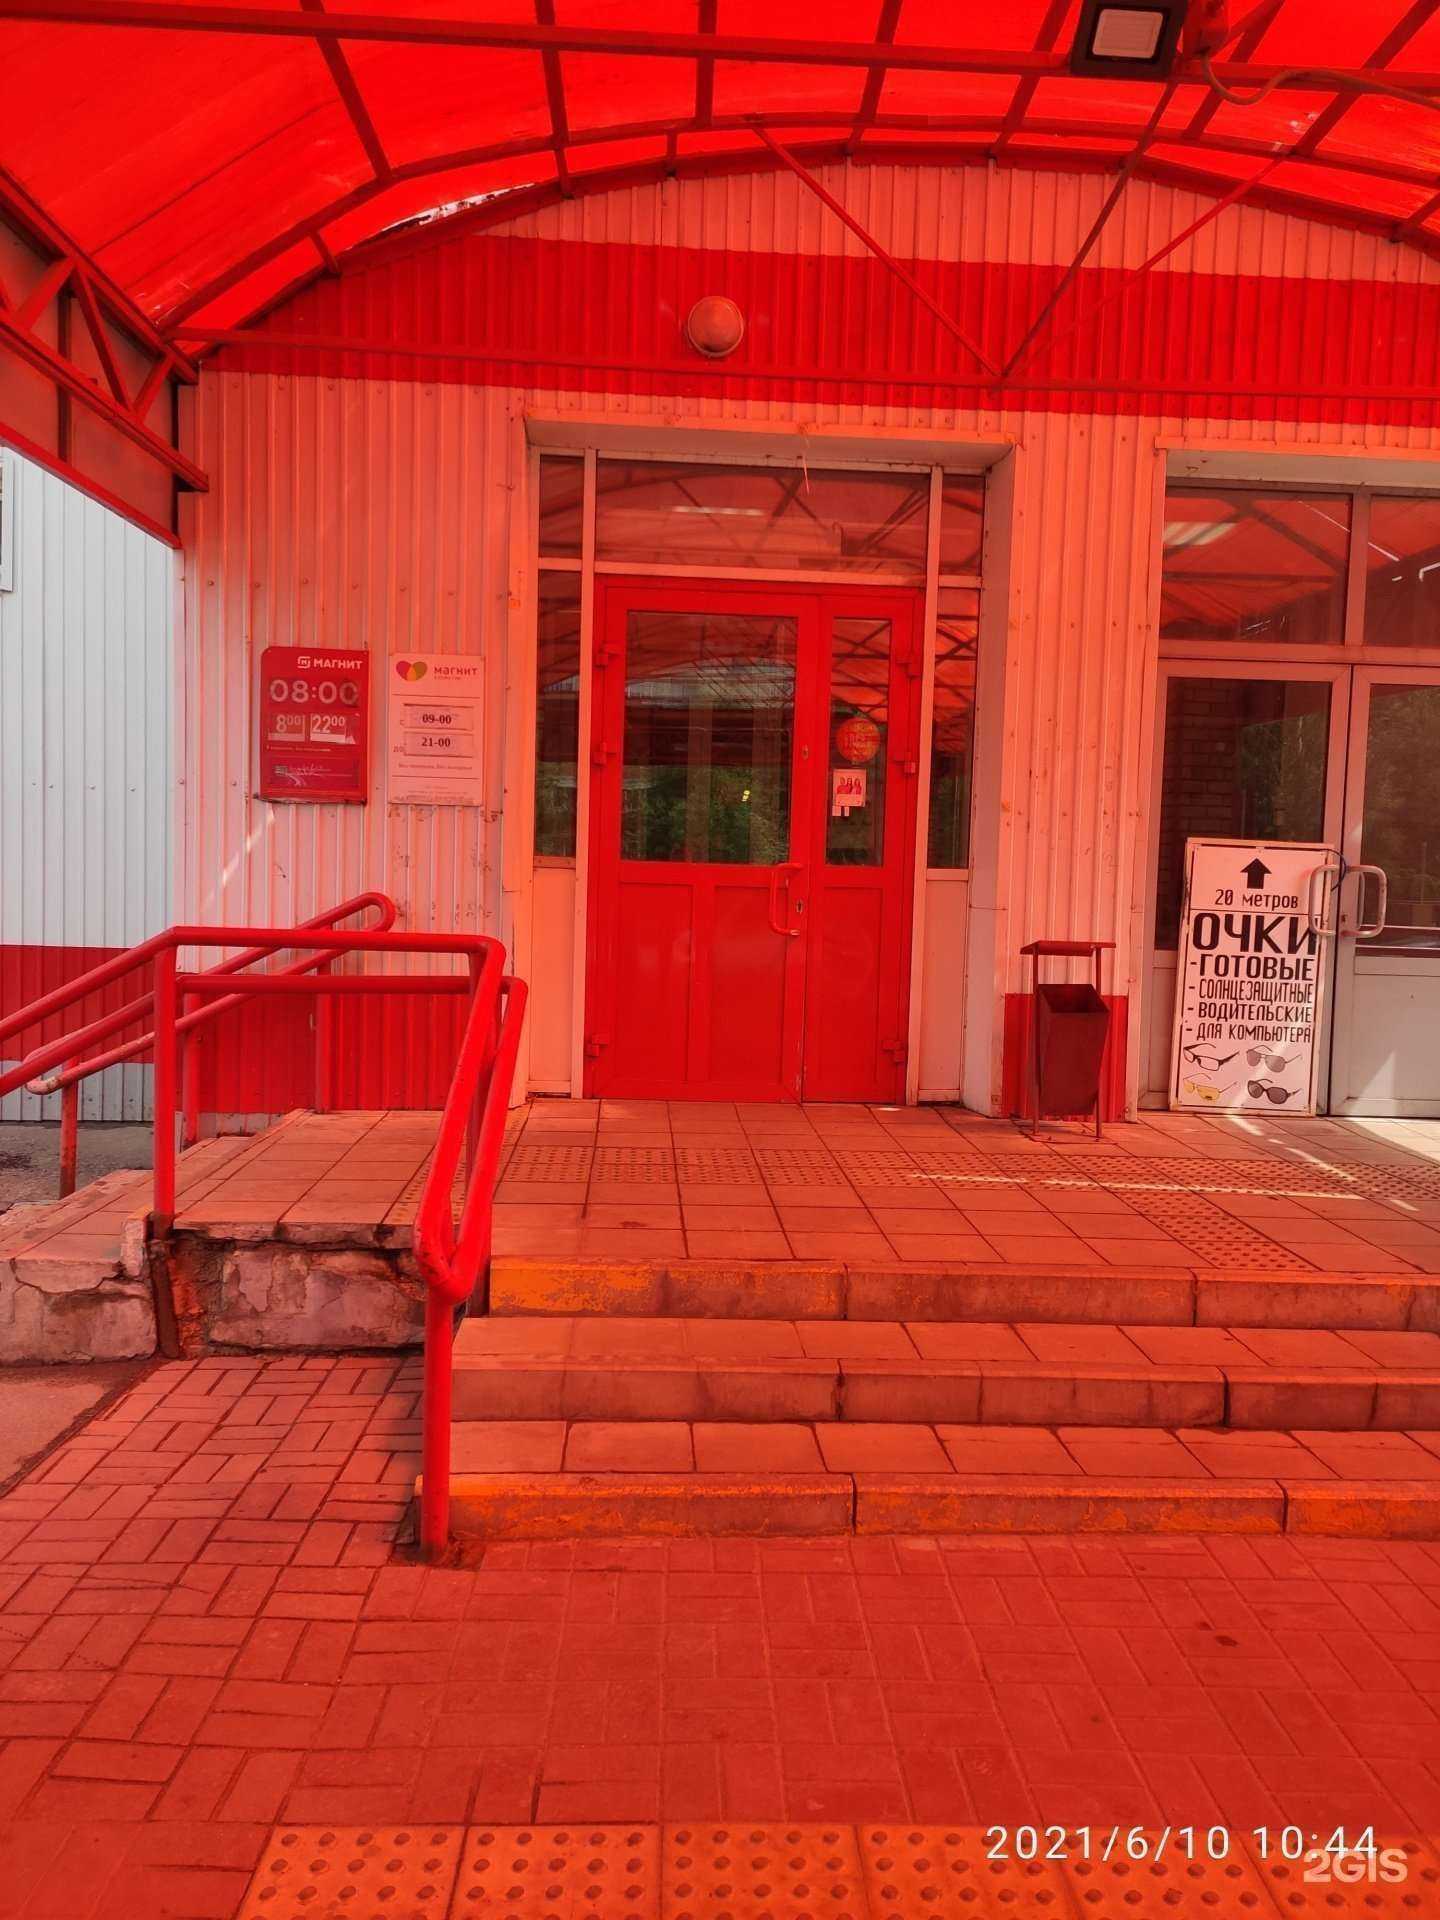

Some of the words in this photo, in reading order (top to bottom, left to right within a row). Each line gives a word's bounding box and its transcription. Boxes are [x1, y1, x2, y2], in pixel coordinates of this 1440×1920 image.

[313, 657, 363, 670] МАГНИТ
[269, 679, 360, 705] 08:00
[421, 713, 453, 725] 09-00
[420, 736, 452, 748] 21-00
[1214, 888, 1234, 906] 20
[1243, 894, 1299, 911] метров
[1192, 912, 1318, 955] ОЧКИ
[1199, 979, 1313, 1005] СОЛНЦЕЗАЩИТНЫЕ
[1197, 1001, 1313, 1024] ВОДИТЕЛЬСКИЕ
[1196, 1022, 1222, 1041] ДЛЯ
[1229, 1024, 1311, 1042] КОМПЬЮТЕРА
